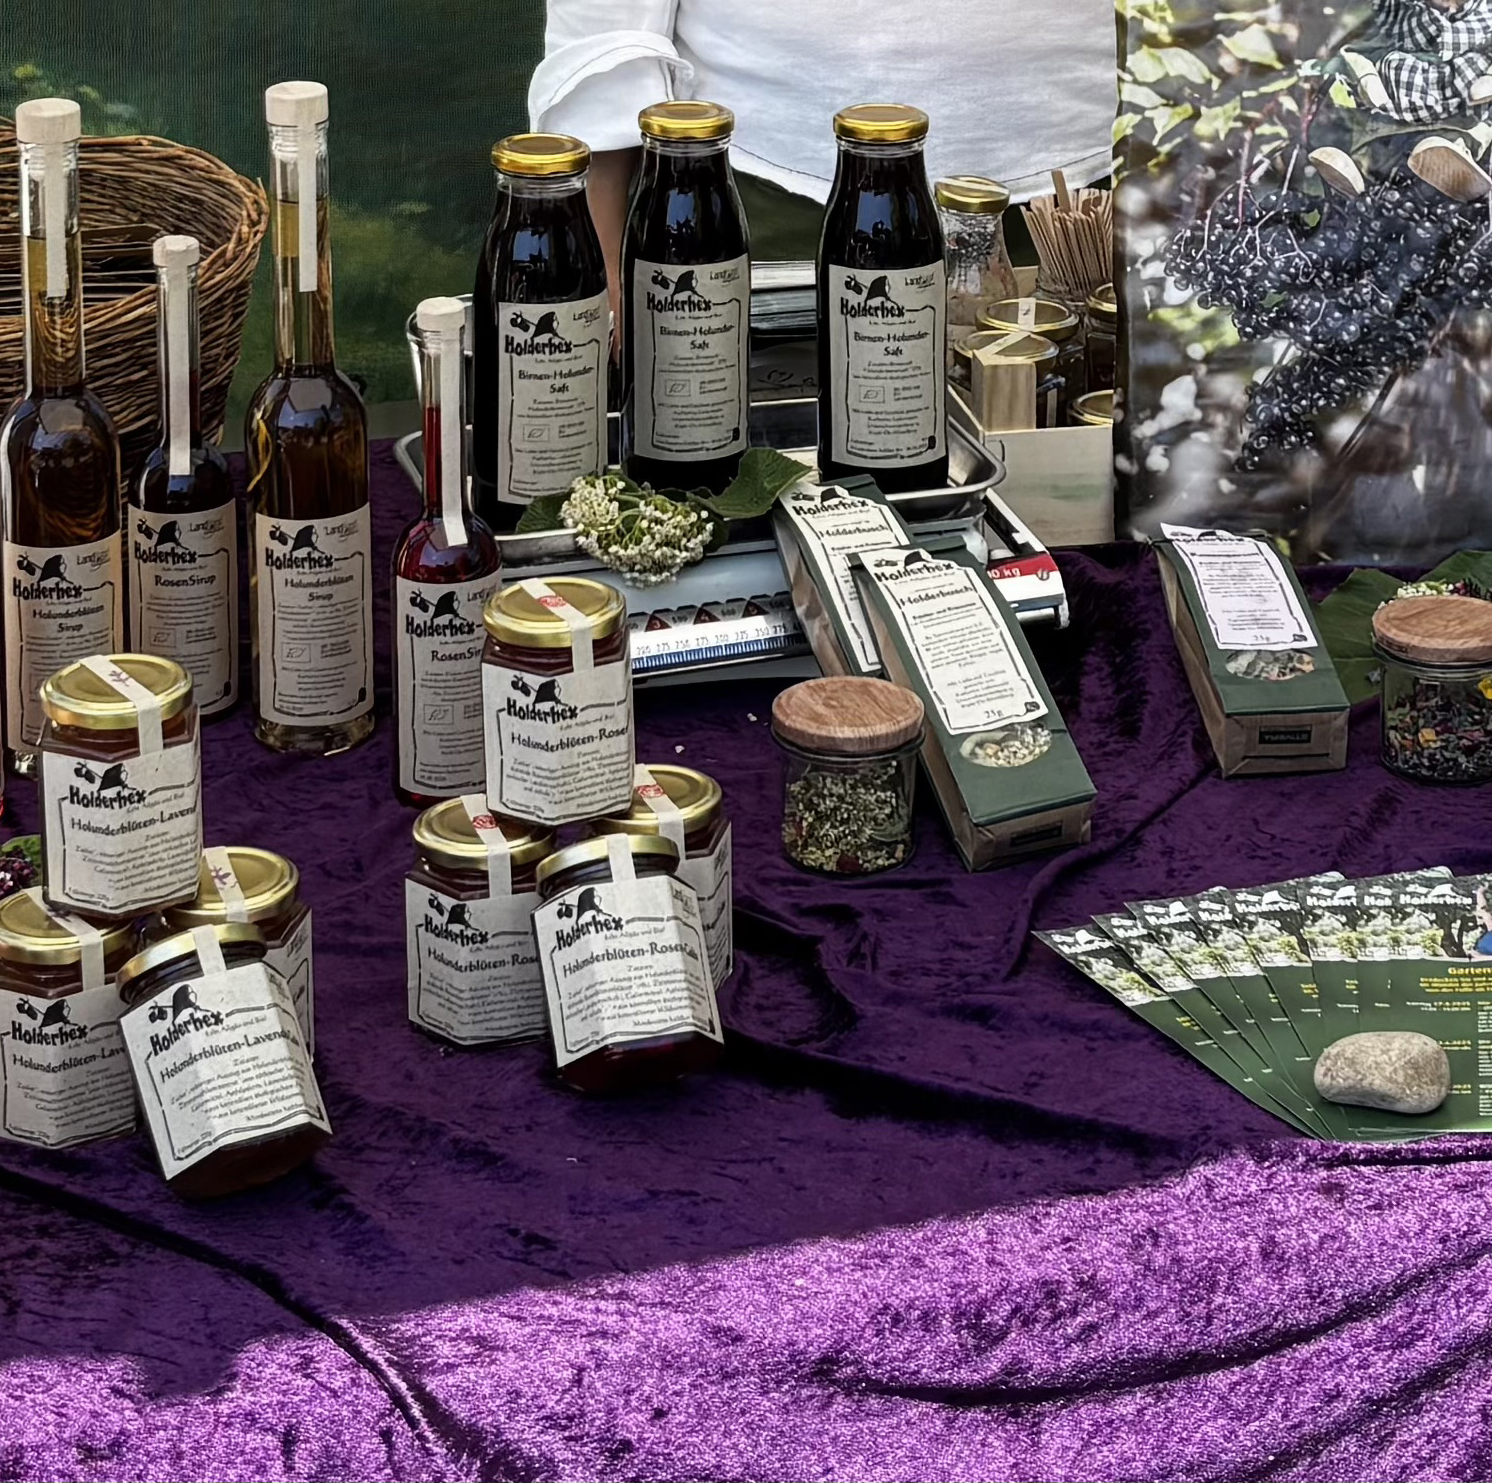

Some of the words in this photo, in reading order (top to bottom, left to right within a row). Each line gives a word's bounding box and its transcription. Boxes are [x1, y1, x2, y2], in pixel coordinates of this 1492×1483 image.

[646, 291, 713, 313] Holderhex
[840, 297, 906, 319] Holderhex
[504, 334, 573, 357] Holderhex
[134, 541, 198, 566] Holderhex
[265, 547, 334, 571] Holderhex
[12, 577, 83, 602] Holderhex
[405, 614, 476, 639] Holderhex
[507, 697, 578, 724] Holderhex
[69, 784, 146, 810] Holderhex
[424, 914, 488, 947] Holderhex
[555, 915, 624, 951] Holderhex
[11, 1020, 88, 1047] Holderhex
[150, 1009, 224, 1055] Holderhex
